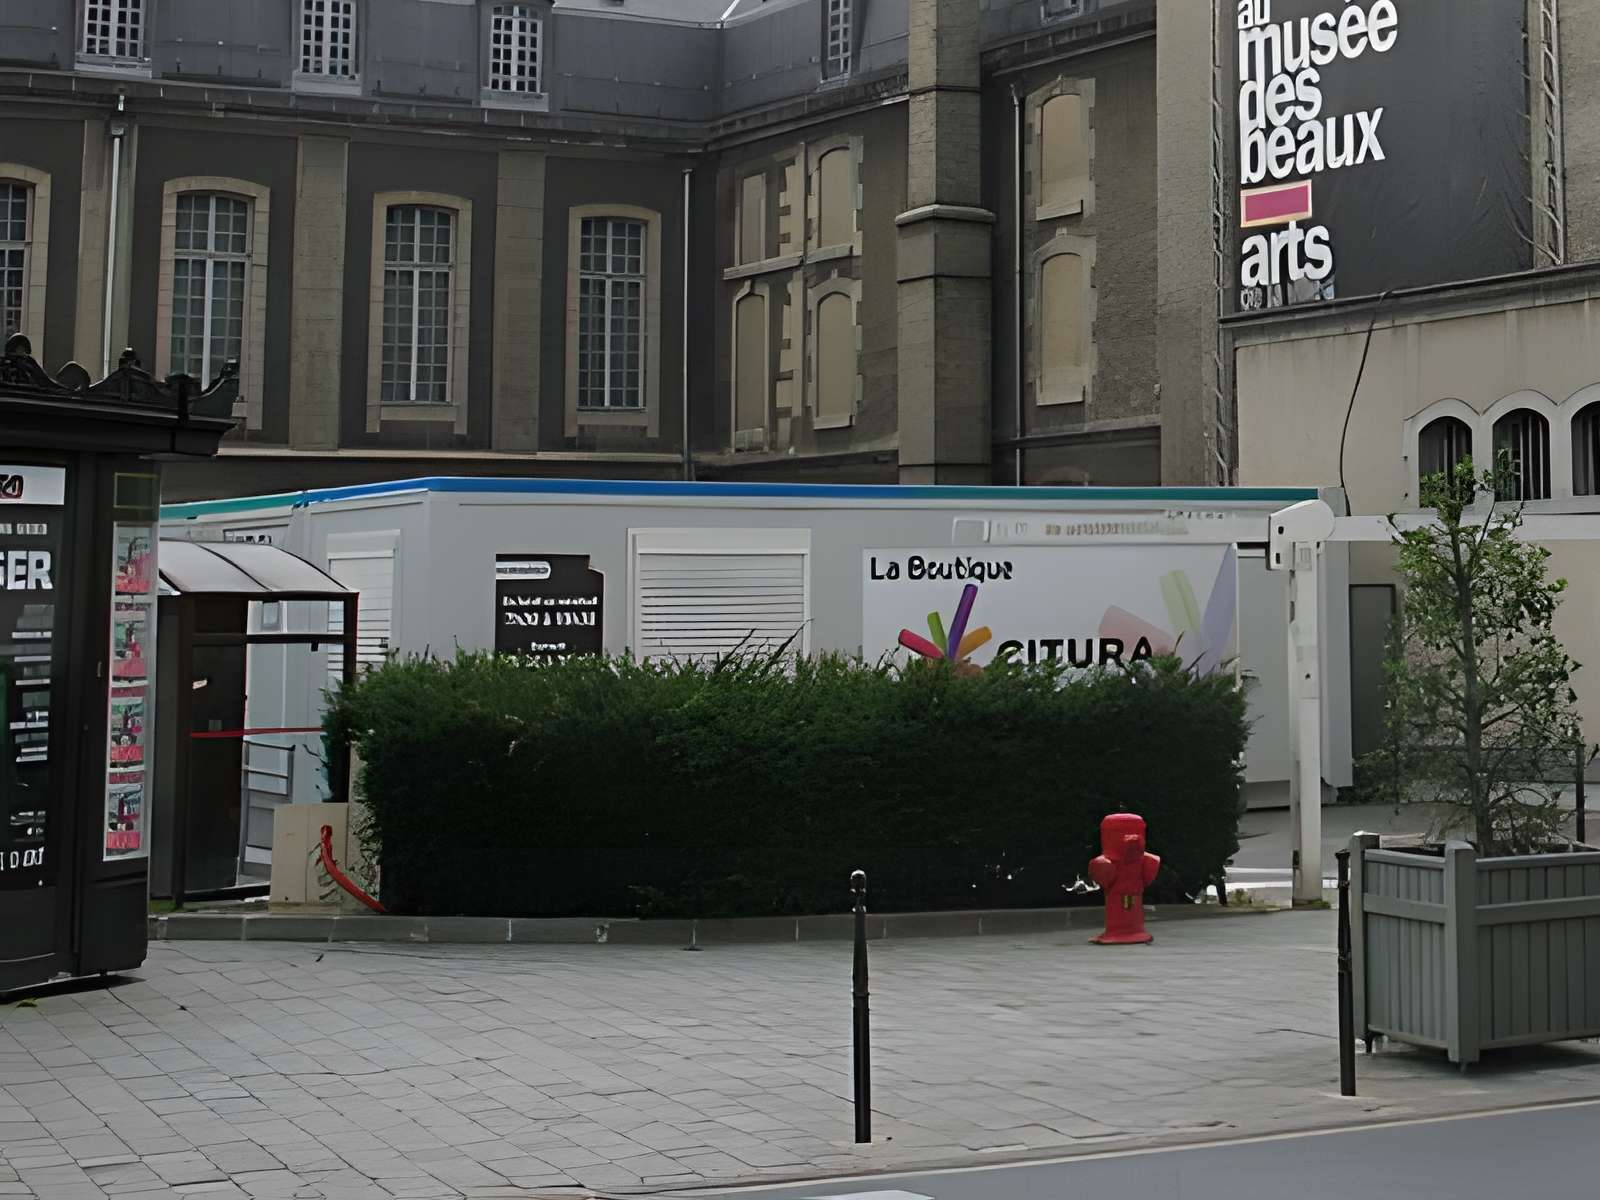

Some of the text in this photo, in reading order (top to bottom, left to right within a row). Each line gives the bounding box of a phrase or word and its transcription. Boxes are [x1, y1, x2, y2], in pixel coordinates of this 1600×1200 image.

[1239, 65, 1323, 129] des
[1240, 107, 1386, 185] beaux
[1241, 221, 1334, 287] arts
[870, 555, 1013, 583] La Boutique
